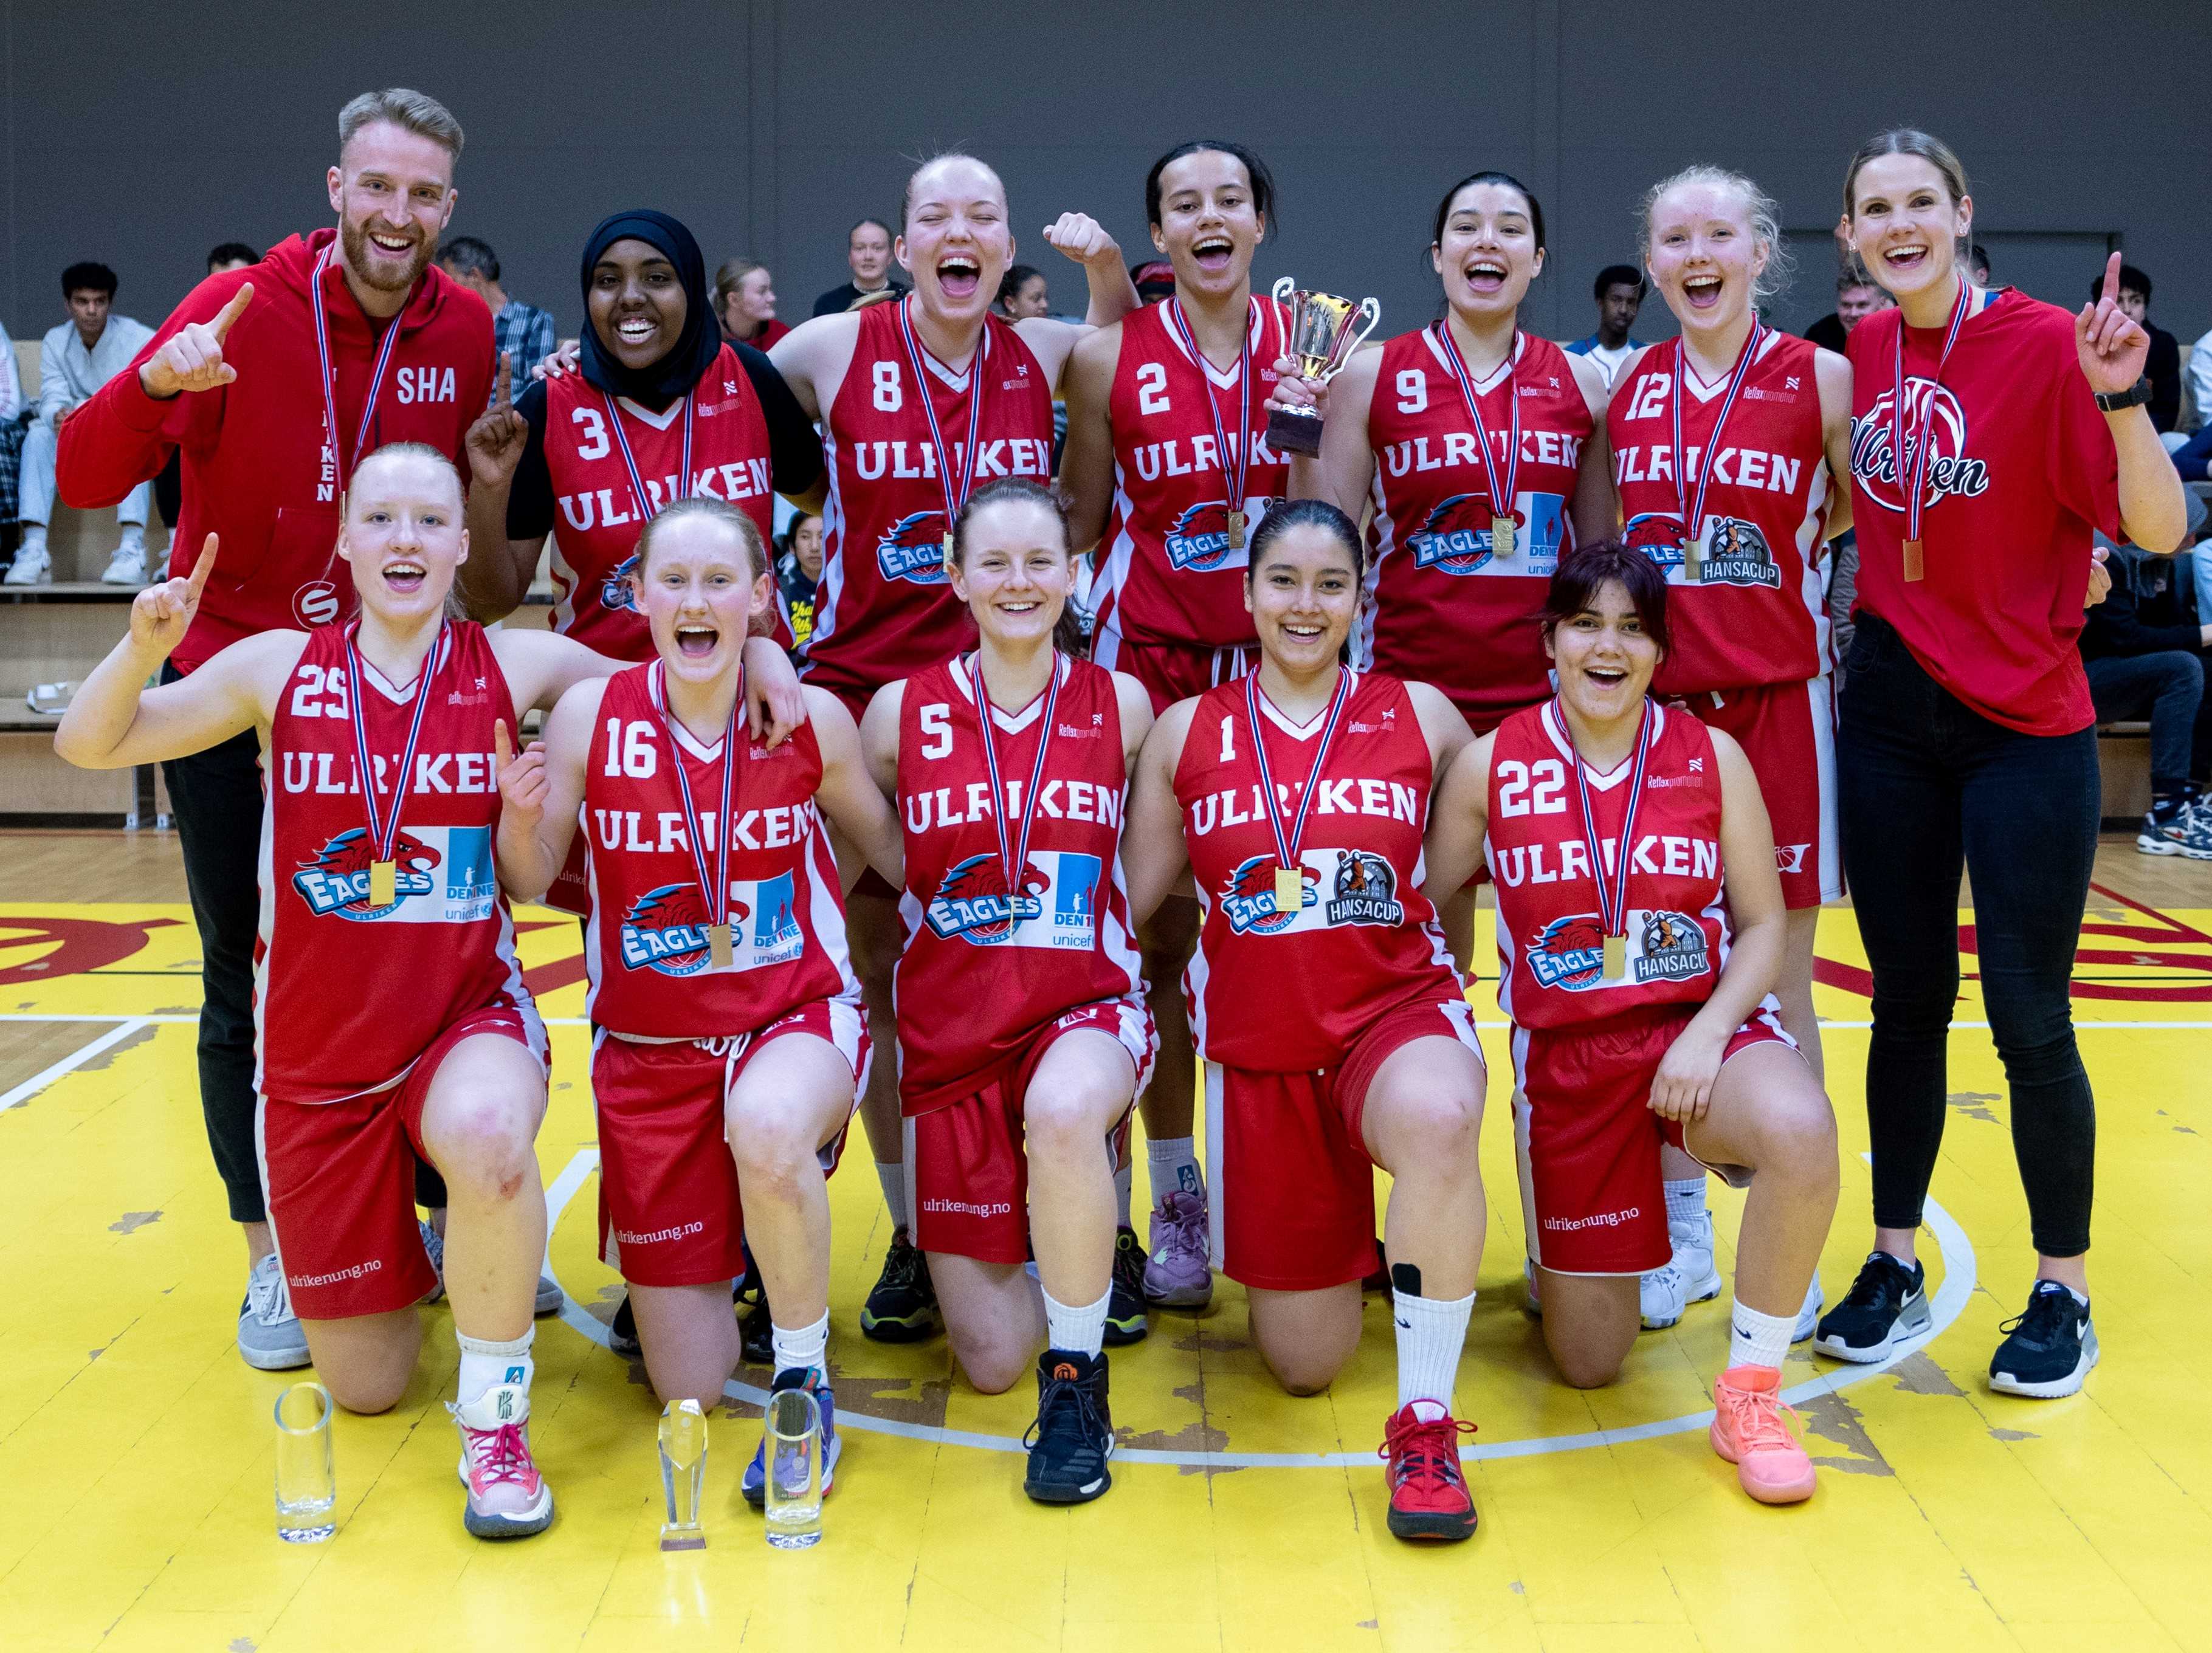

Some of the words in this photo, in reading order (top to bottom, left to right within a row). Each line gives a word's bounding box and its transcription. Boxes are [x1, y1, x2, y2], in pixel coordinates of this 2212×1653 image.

[397, 367, 455, 404] SHA
[872, 360, 903, 411] 8
[1137, 363, 1170, 415] 2
[1396, 369, 1427, 414] 9
[1625, 373, 1671, 421] 12
[572, 407, 610, 460] 3
[1615, 445, 1800, 495] ULRIKEN
[881, 546, 944, 574] EAGL
[1173, 532, 1229, 563] EAGLE
[1411, 531, 1493, 562] EAGLE
[1704, 560, 1776, 581] HANSACUP
[604, 718, 656, 778] 16
[920, 703, 953, 760] 5
[1220, 715, 1236, 763] 1
[283, 752, 518, 794] ULRKE
[1497, 758, 1566, 818] 22
[906, 780, 1118, 834] ULRIKEN
[1192, 778, 1417, 836] ULRKEN
[594, 802, 813, 852] ULRIKEN
[1497, 836, 1718, 887] ULRIKEN
[301, 872, 430, 907] EAGES
[1227, 890, 1314, 926] EAGS
[930, 896, 1040, 933] EAGLES
[1331, 901, 1399, 922] HANSACUP
[754, 946, 791, 964] unicef
[1053, 933, 1092, 947] unicef
[1537, 949, 1604, 981] EAGLE
[1638, 950, 1707, 978] HANSACU
[923, 1198, 1010, 1218] ulrikenung.no
[1544, 1206, 1639, 1232] ulrikenung.no
[615, 1220, 703, 1244] ulrikenung.no
[289, 1259, 382, 1288] ulrikenung.no
